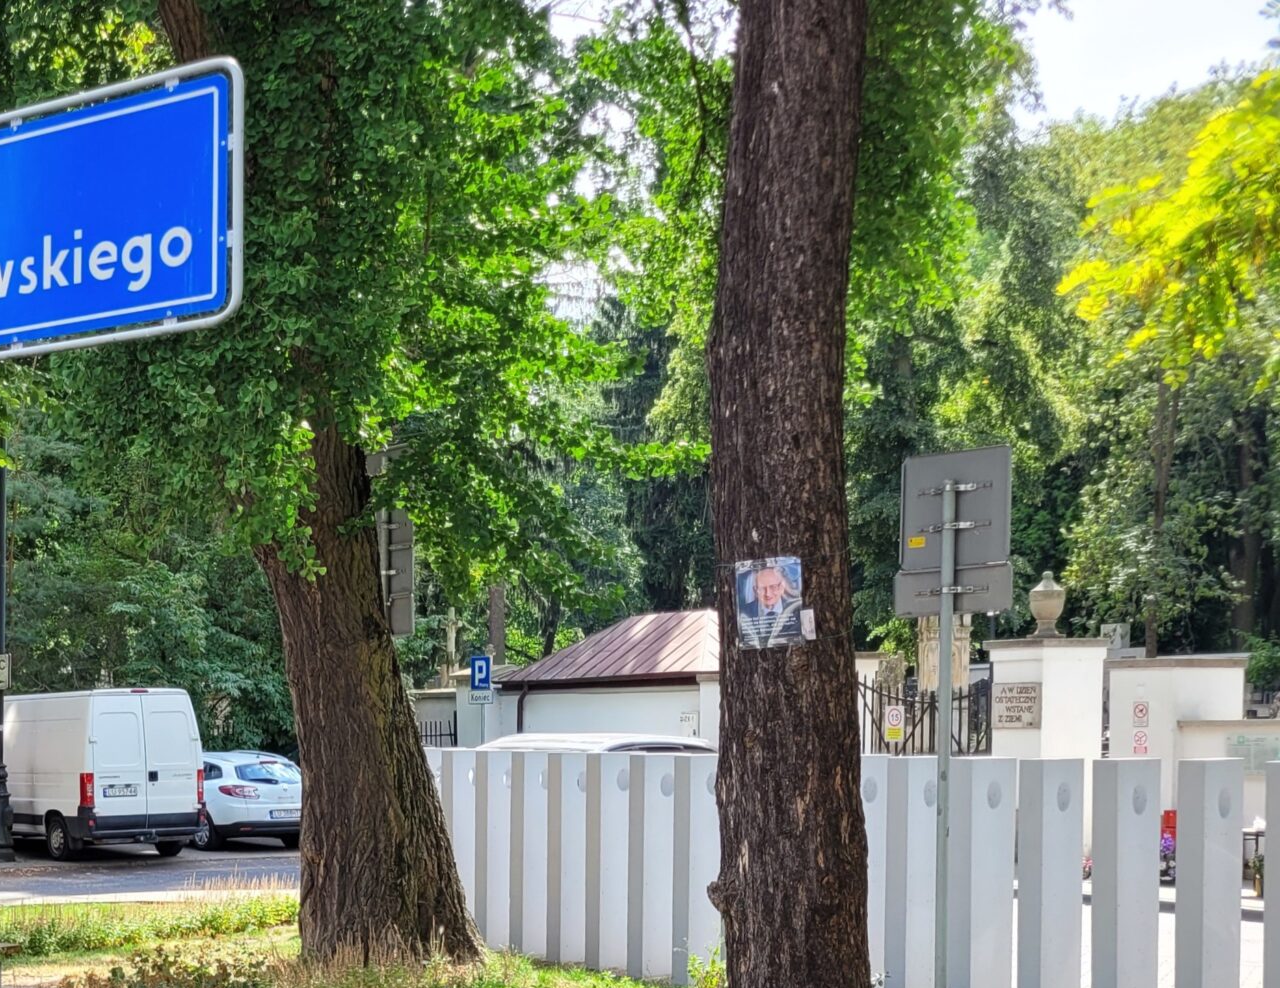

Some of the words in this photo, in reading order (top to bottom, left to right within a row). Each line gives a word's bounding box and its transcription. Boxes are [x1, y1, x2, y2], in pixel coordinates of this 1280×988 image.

[470, 693, 490, 702] Koniec
[995, 695, 1037, 704] OSTATECZNY
[890, 713, 900, 722] 15
